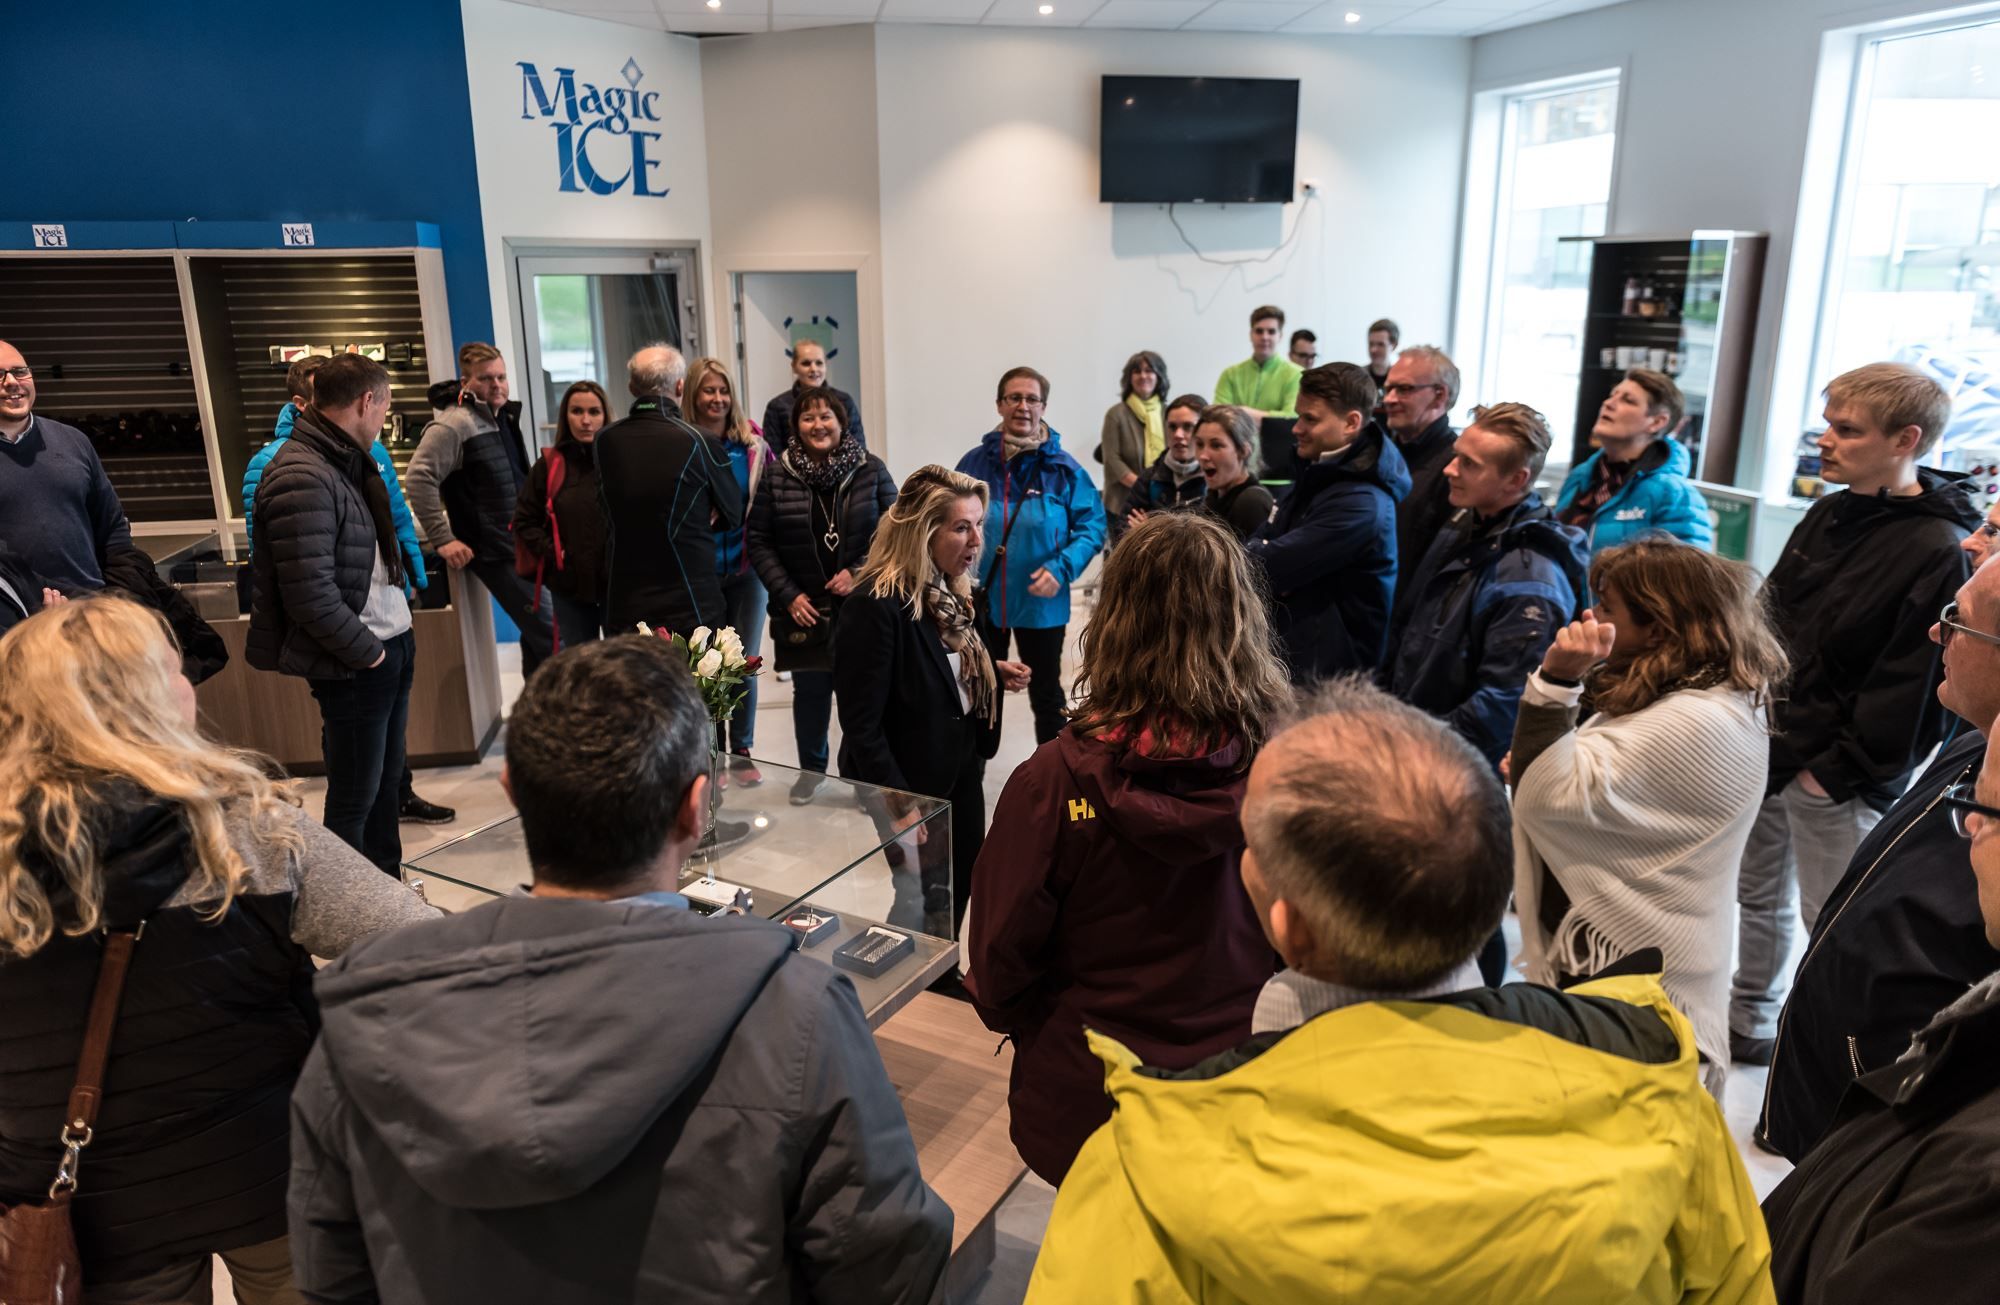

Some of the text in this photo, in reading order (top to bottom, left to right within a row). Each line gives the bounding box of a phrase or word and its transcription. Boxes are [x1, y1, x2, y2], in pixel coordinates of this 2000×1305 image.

[515, 57, 662, 135] Magic
[549, 118, 671, 198] ICE
[34, 226, 64, 237] Magic
[42, 235, 65, 246] ICE
